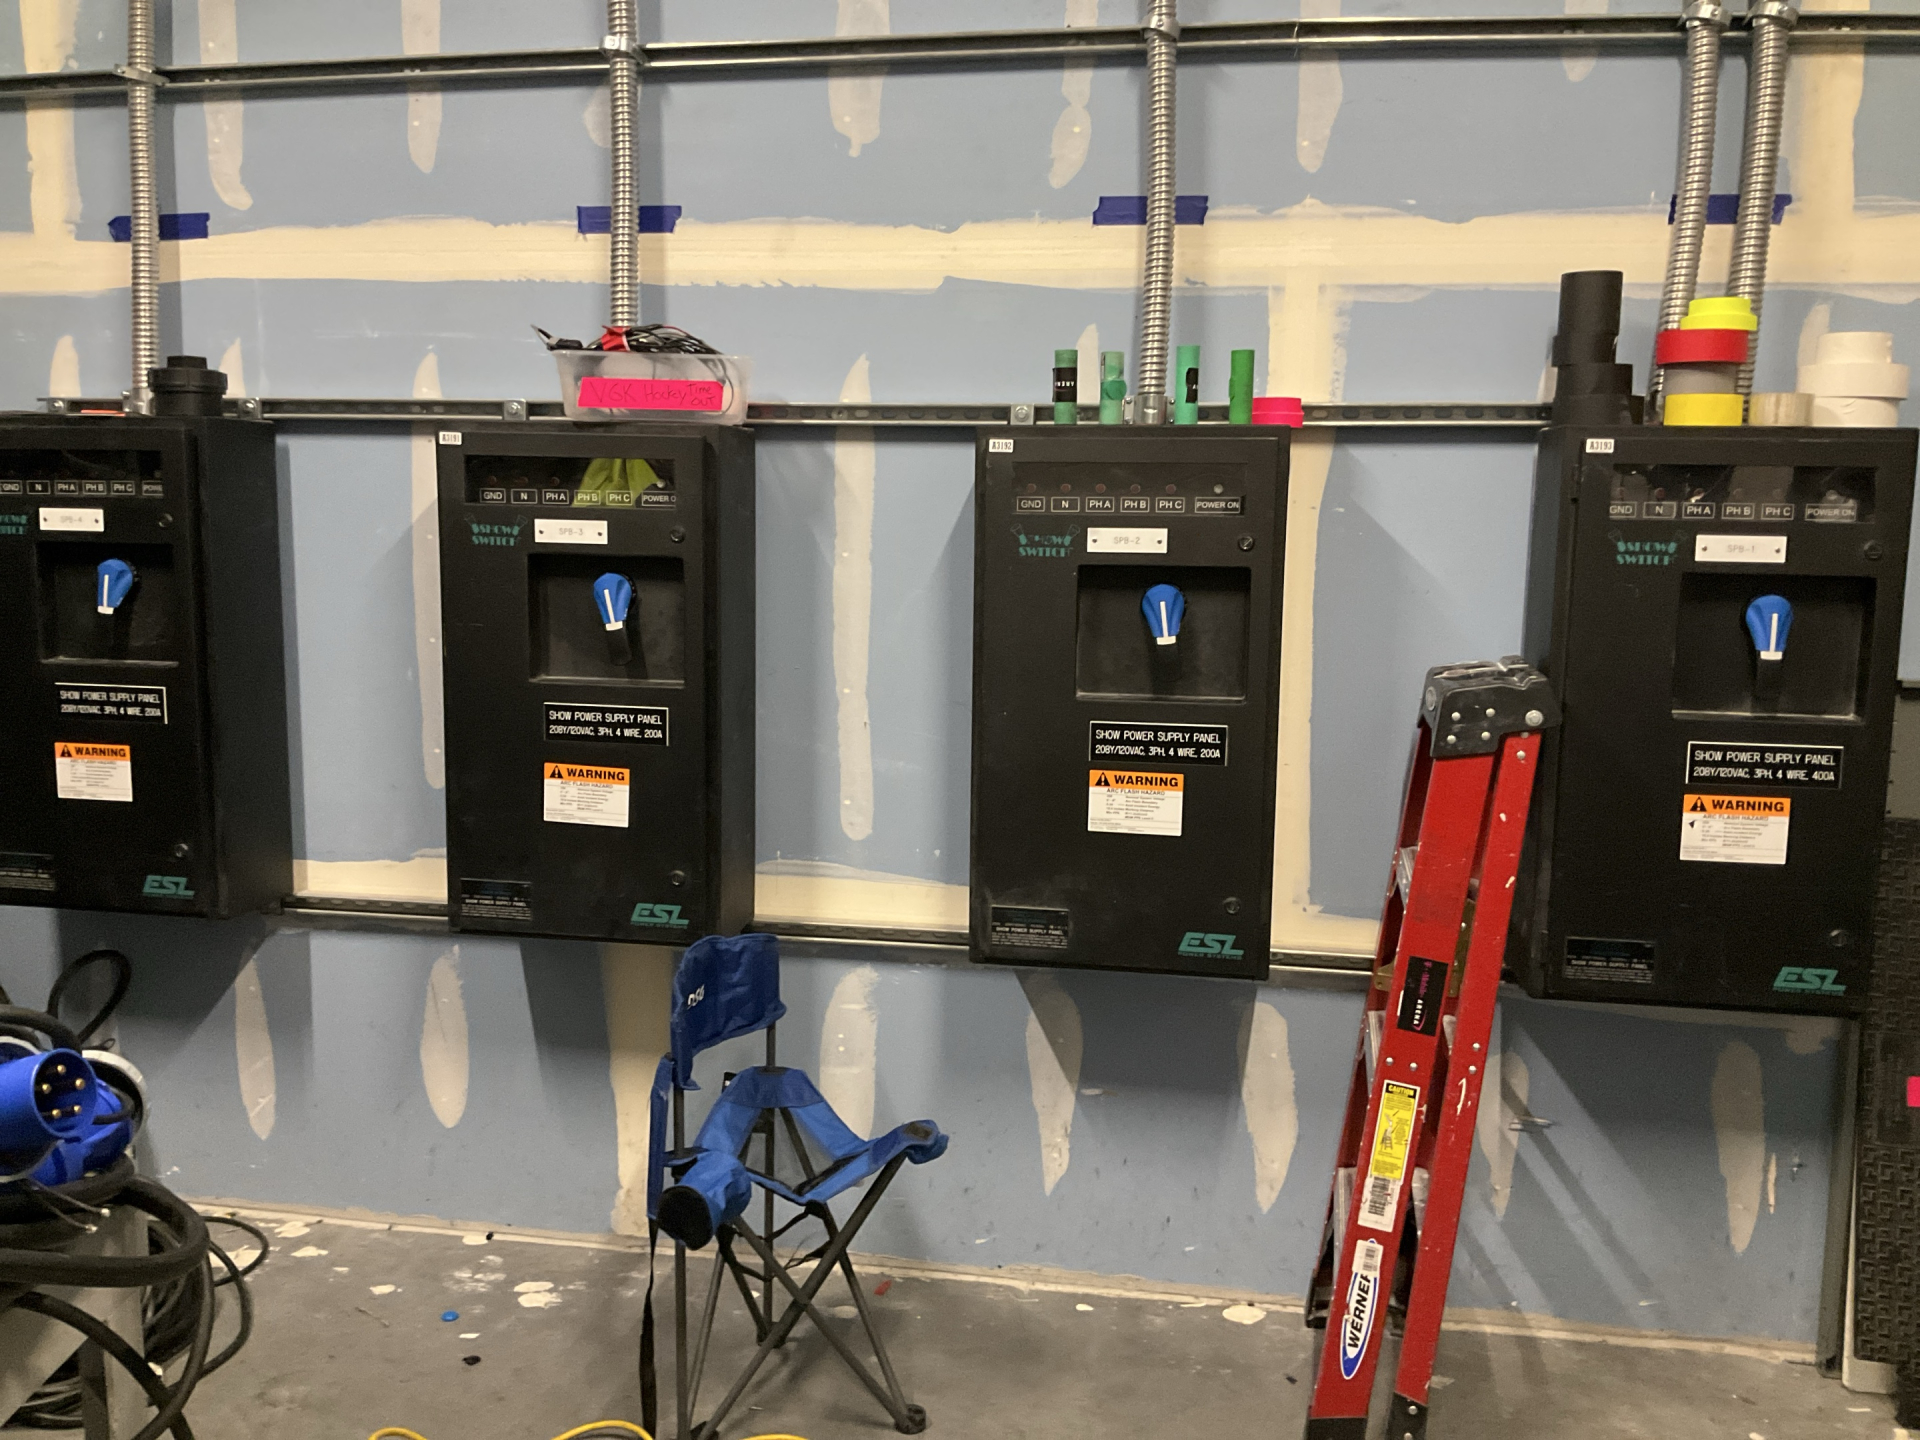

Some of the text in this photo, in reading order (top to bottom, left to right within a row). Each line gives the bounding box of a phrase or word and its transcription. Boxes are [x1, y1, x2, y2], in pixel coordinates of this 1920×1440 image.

[590, 381, 711, 406] VGK Hockey Time
[992, 441, 1012, 450] A3192
[1590, 441, 1612, 450] A3193
[3, 483, 19, 492] GND
[35, 483, 42, 492] N
[58, 483, 76, 492] PH A
[85, 483, 104, 492] PH B
[113, 483, 133, 492] PH C
[483, 492, 503, 500] GND
[520, 492, 528, 500] N
[546, 492, 566, 501] PH A
[577, 493, 598, 501] PH B
[609, 493, 631, 502] PH C
[1021, 500, 1042, 508] GND
[1062, 500, 1069, 508] N
[1089, 500, 1111, 508] PH A
[1124, 501, 1147, 509] PH B
[1160, 501, 1182, 509] PH C
[1196, 501, 1226, 509] POWER
[1609, 506, 1632, 514] GND
[1655, 506, 1663, 514] N
[1686, 506, 1711, 514] PH A
[1765, 508, 1791, 516] PH C
[1807, 508, 1839, 516] POWER
[559, 527, 583, 536] SPB-3
[1113, 537, 1140, 545] SPB-2
[1019, 546, 1072, 557] SWITCH
[1727, 545, 1755, 553] SPB-1
[60, 691, 160, 703] SHOW POWER SUPPLY PANEL
[120, 707, 125, 715] 4
[145, 707, 161, 716] 200A
[549, 711, 662, 724] SHOW POWER SUPPLY PANEL
[616, 728, 621, 736] 4
[644, 729, 663, 738] 200A
[1096, 730, 1221, 743] SHOW POWER SUPPLY PANEL
[75, 747, 126, 757] WARNING
[1168, 747, 1174, 756] 4
[1200, 749, 1220, 758] 200A
[1695, 750, 1836, 765] SHOW POWER SUPPLY PANEL
[567, 768, 625, 781] WARNING
[1776, 770, 1783, 779] 4
[1812, 771, 1835, 781] 400A
[1114, 775, 1178, 787] WARNING
[1712, 799, 1785, 812] WARNING
[143, 875, 195, 896] ESL
[630, 903, 690, 925] ESL
[1179, 931, 1245, 956] ESL
[1773, 966, 1847, 991] ESL
[1388, 1085, 1414, 1096] CAUTION
